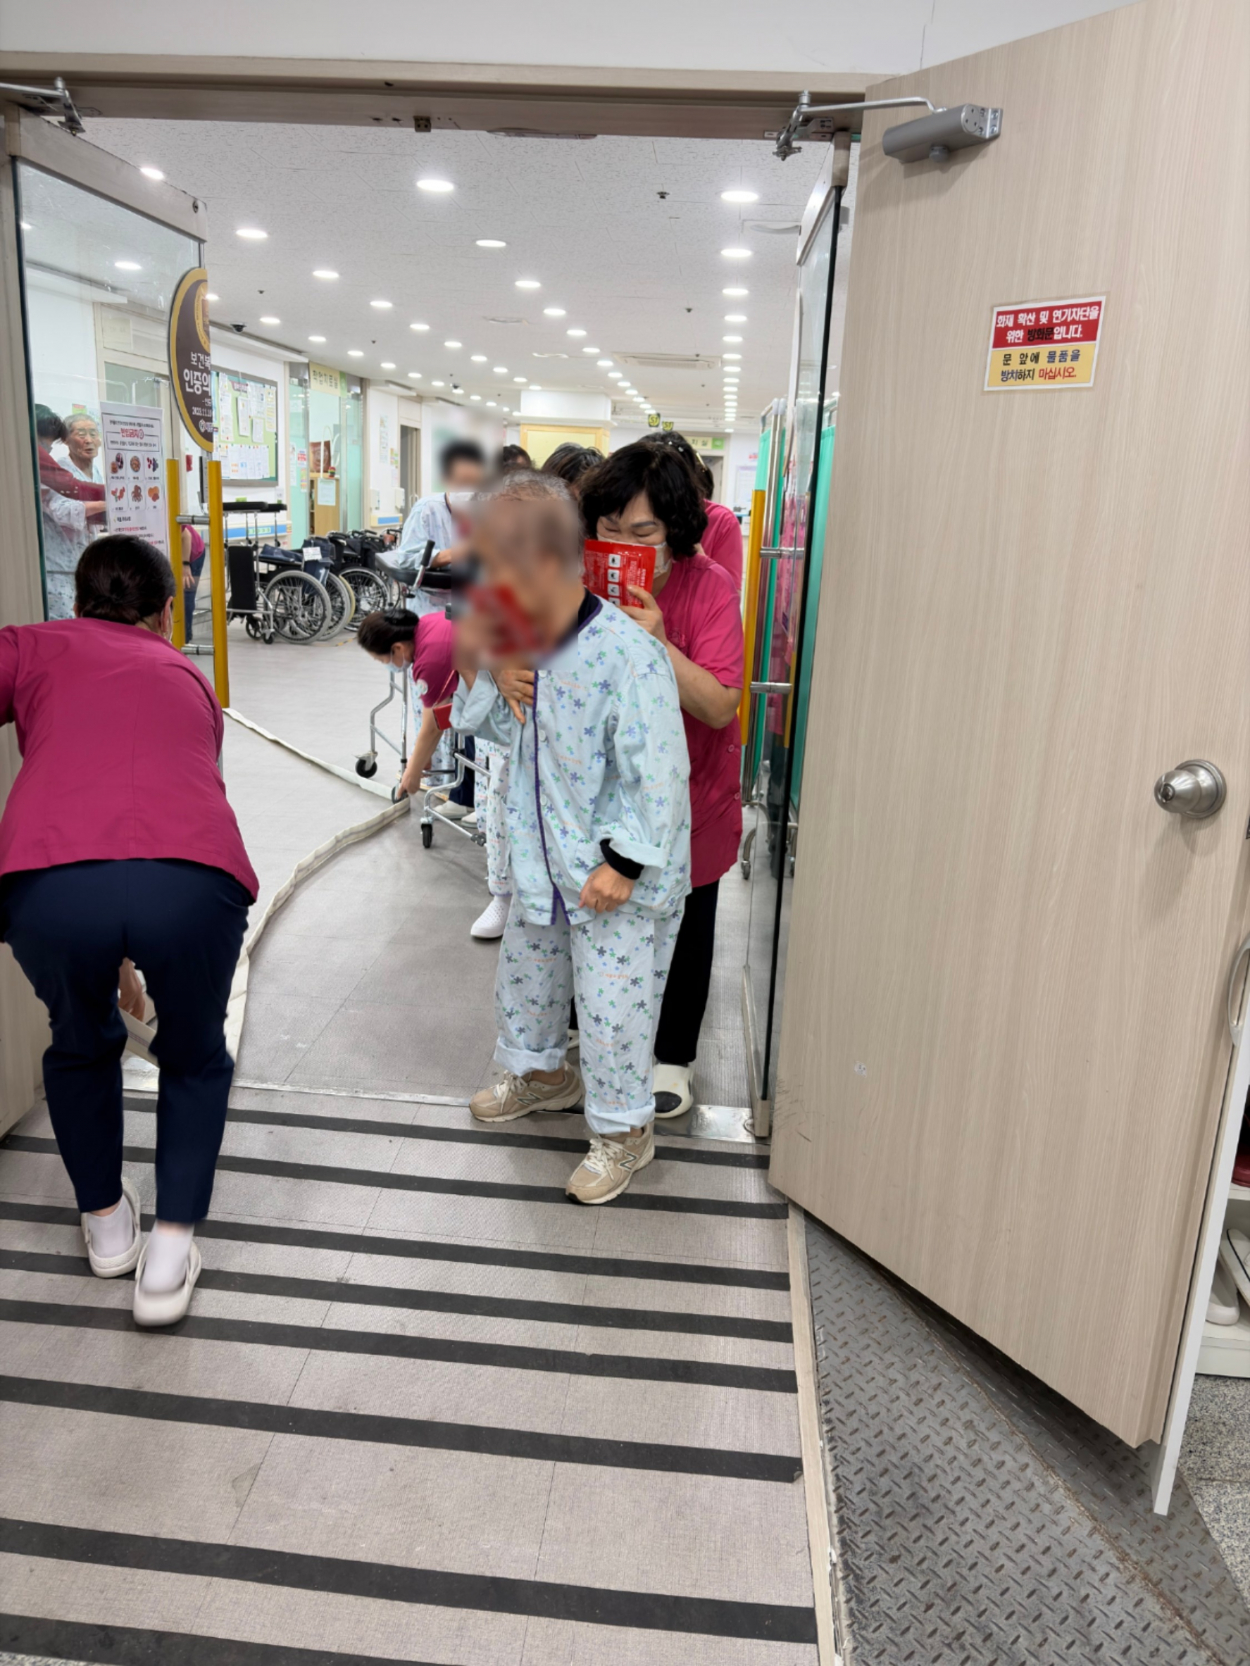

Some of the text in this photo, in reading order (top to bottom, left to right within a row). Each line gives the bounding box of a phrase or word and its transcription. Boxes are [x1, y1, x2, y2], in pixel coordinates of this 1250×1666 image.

[996, 305, 1099, 328] 화재 확산 및 연기차단을
[1006, 324, 1083, 343] 위한 방화문입니다.
[1002, 349, 1081, 366] 문 앞에 물품을
[1000, 366, 1077, 382] 방치하지 마십시오.
